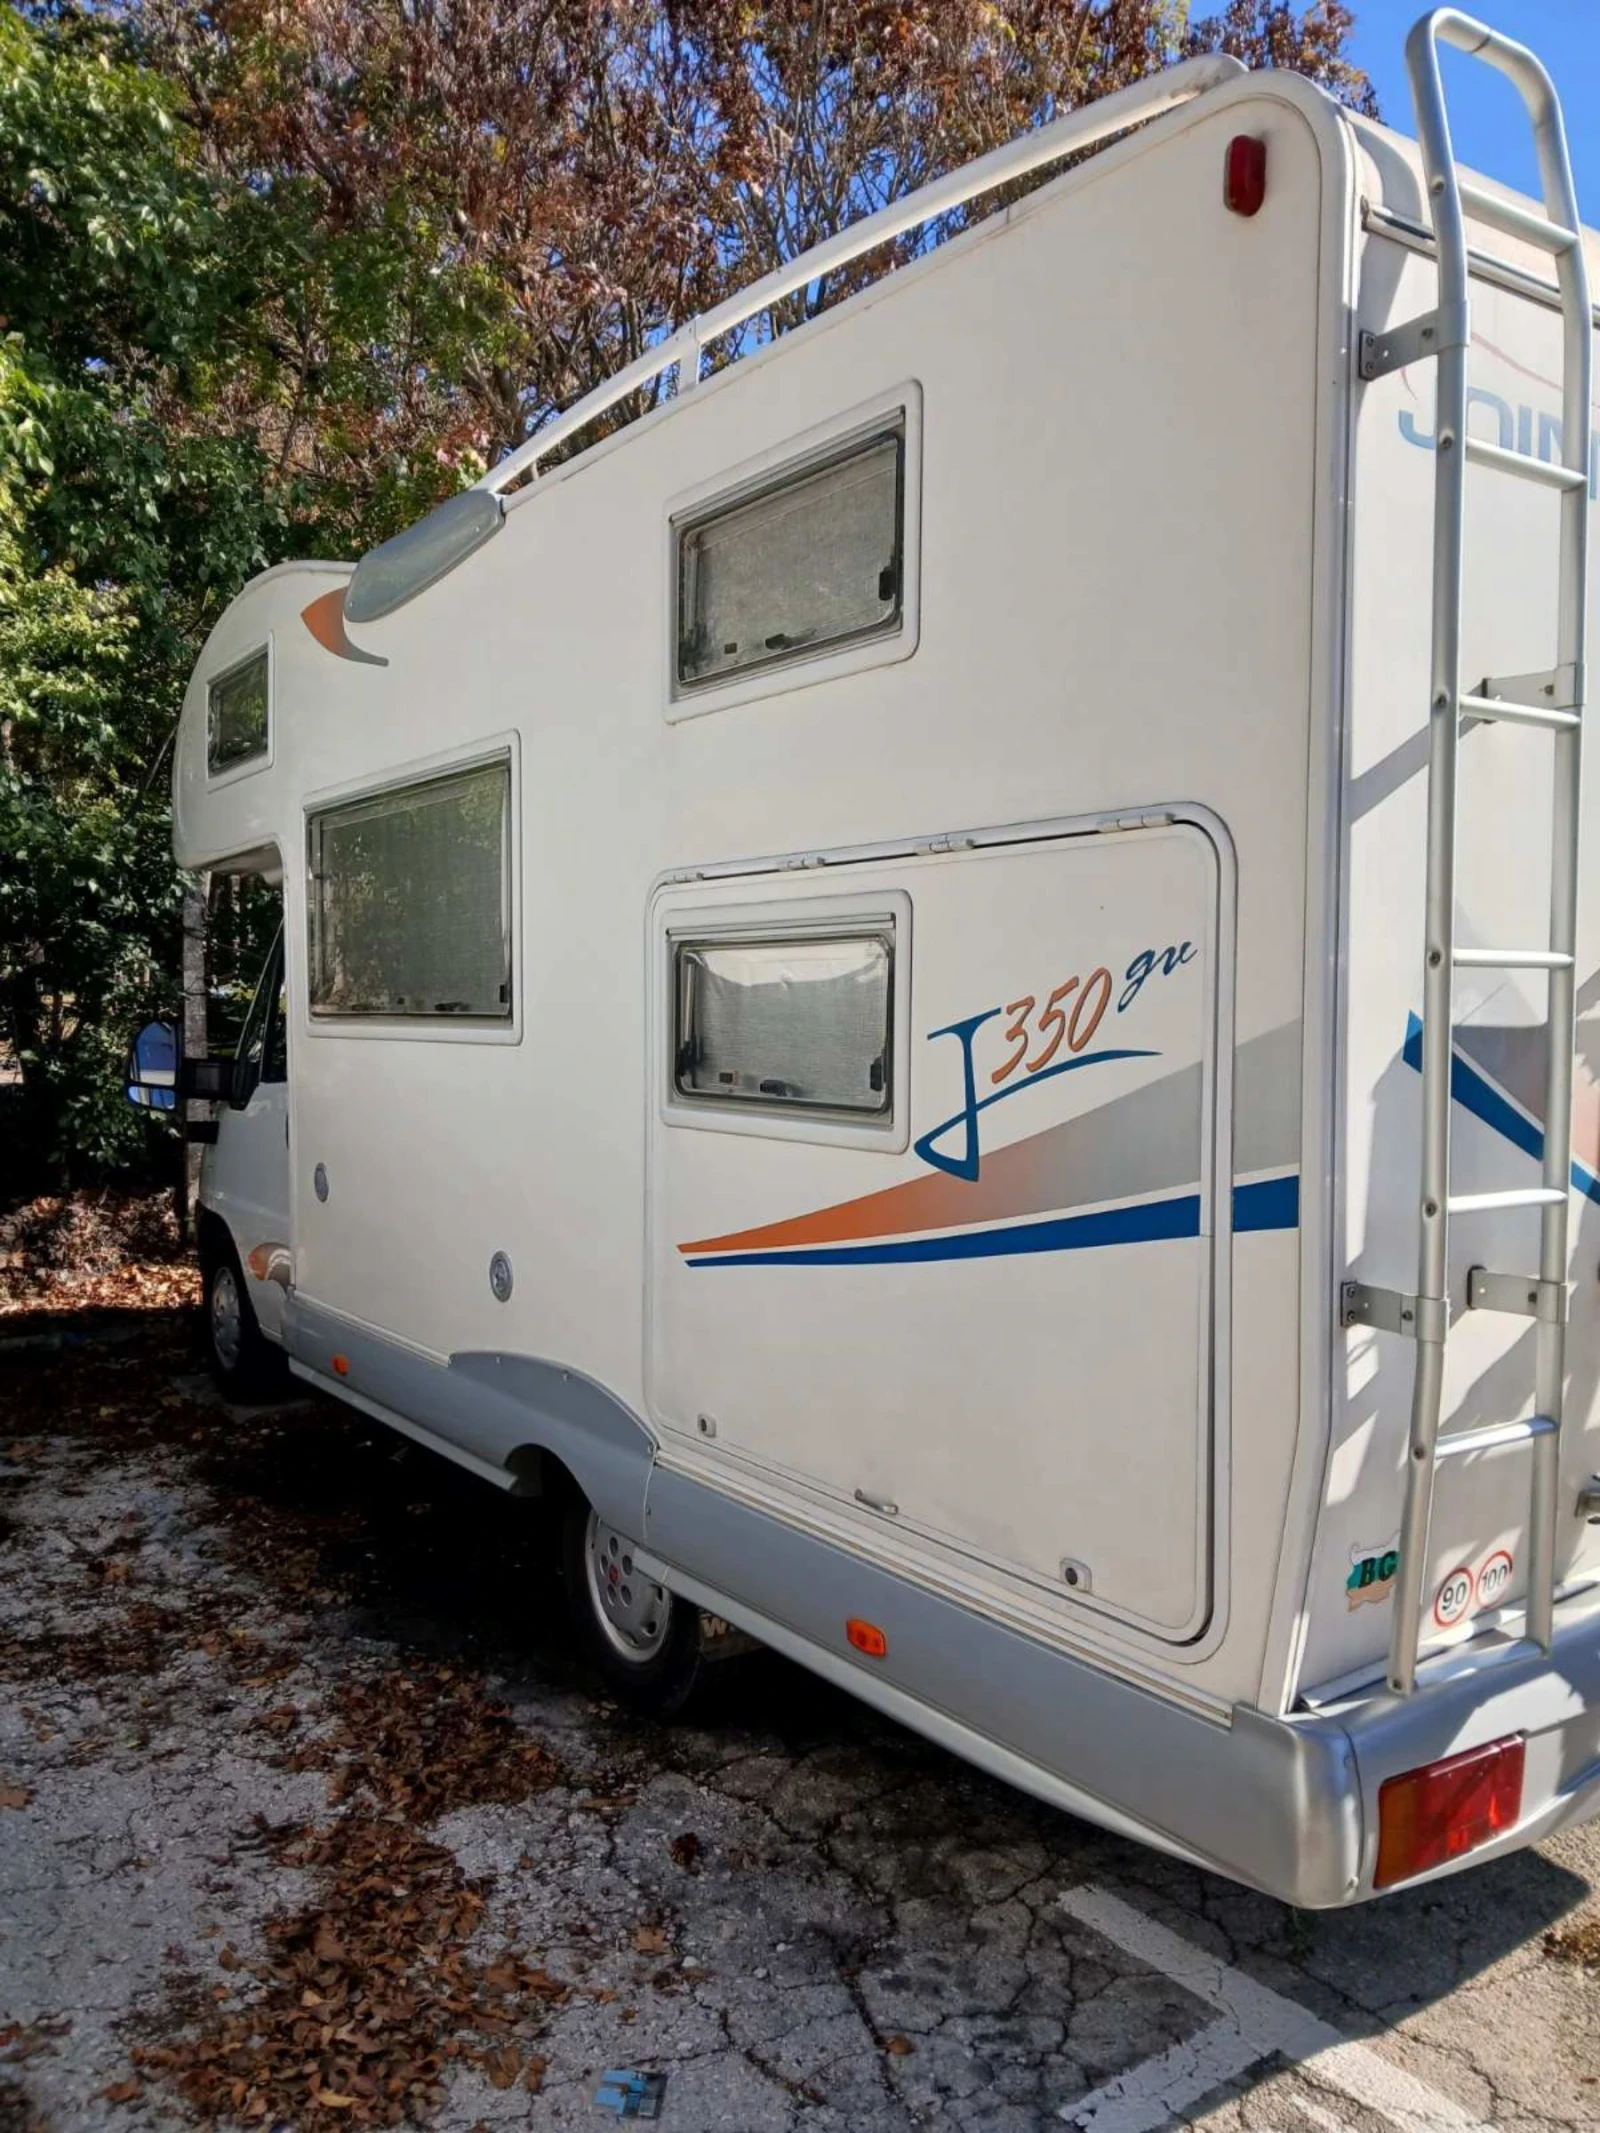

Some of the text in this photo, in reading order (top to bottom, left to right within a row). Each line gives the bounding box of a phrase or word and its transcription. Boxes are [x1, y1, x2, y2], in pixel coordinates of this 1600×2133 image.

[1358, 1550, 1399, 1588] BG
[1481, 1565, 1508, 1592] 100
[1443, 1582, 1466, 1610] 90
